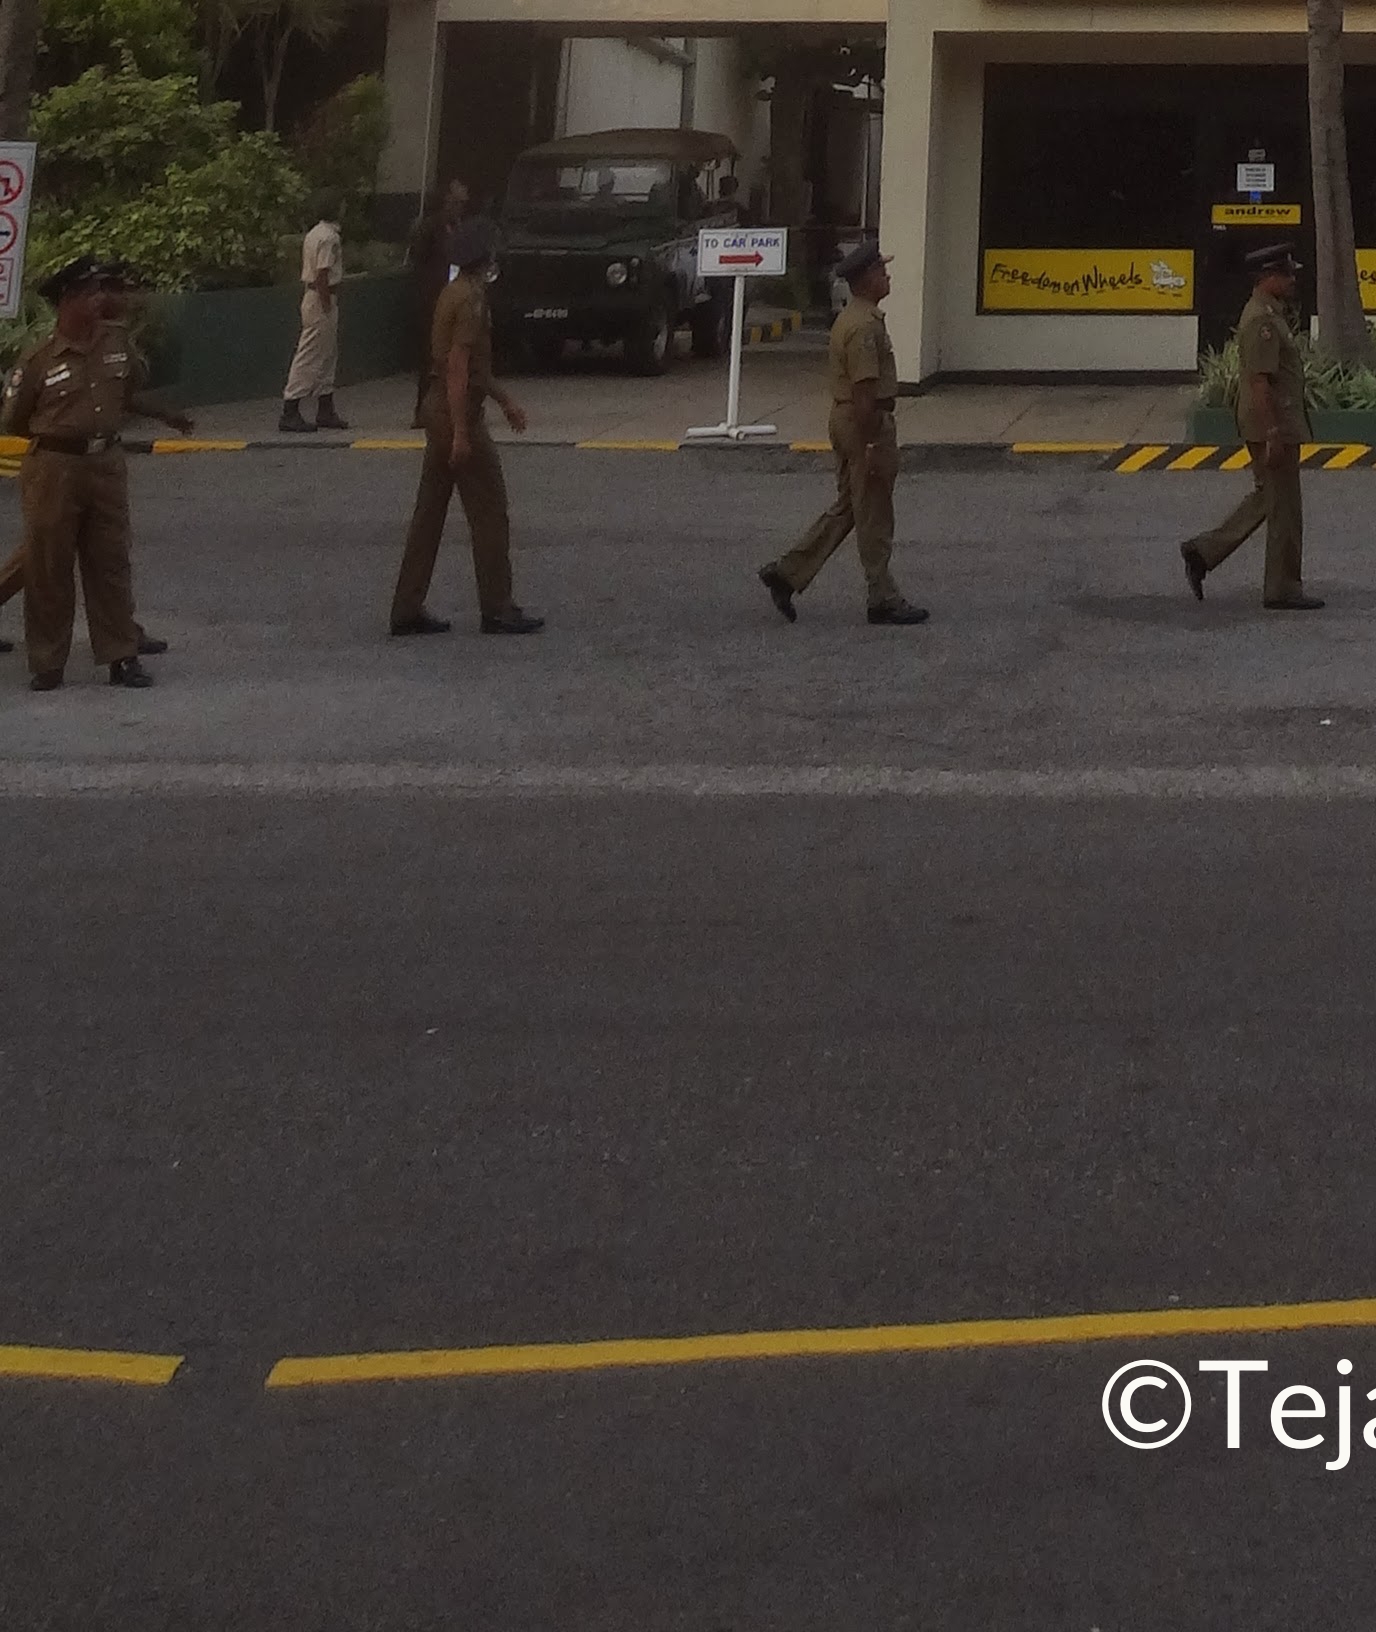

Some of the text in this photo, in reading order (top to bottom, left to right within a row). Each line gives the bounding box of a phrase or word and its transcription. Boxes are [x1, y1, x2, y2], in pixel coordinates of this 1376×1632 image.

[1225, 207, 1290, 215] andrew
[705, 238, 779, 248] TO CAR PARK
[1082, 262, 1143, 292] Wheels
